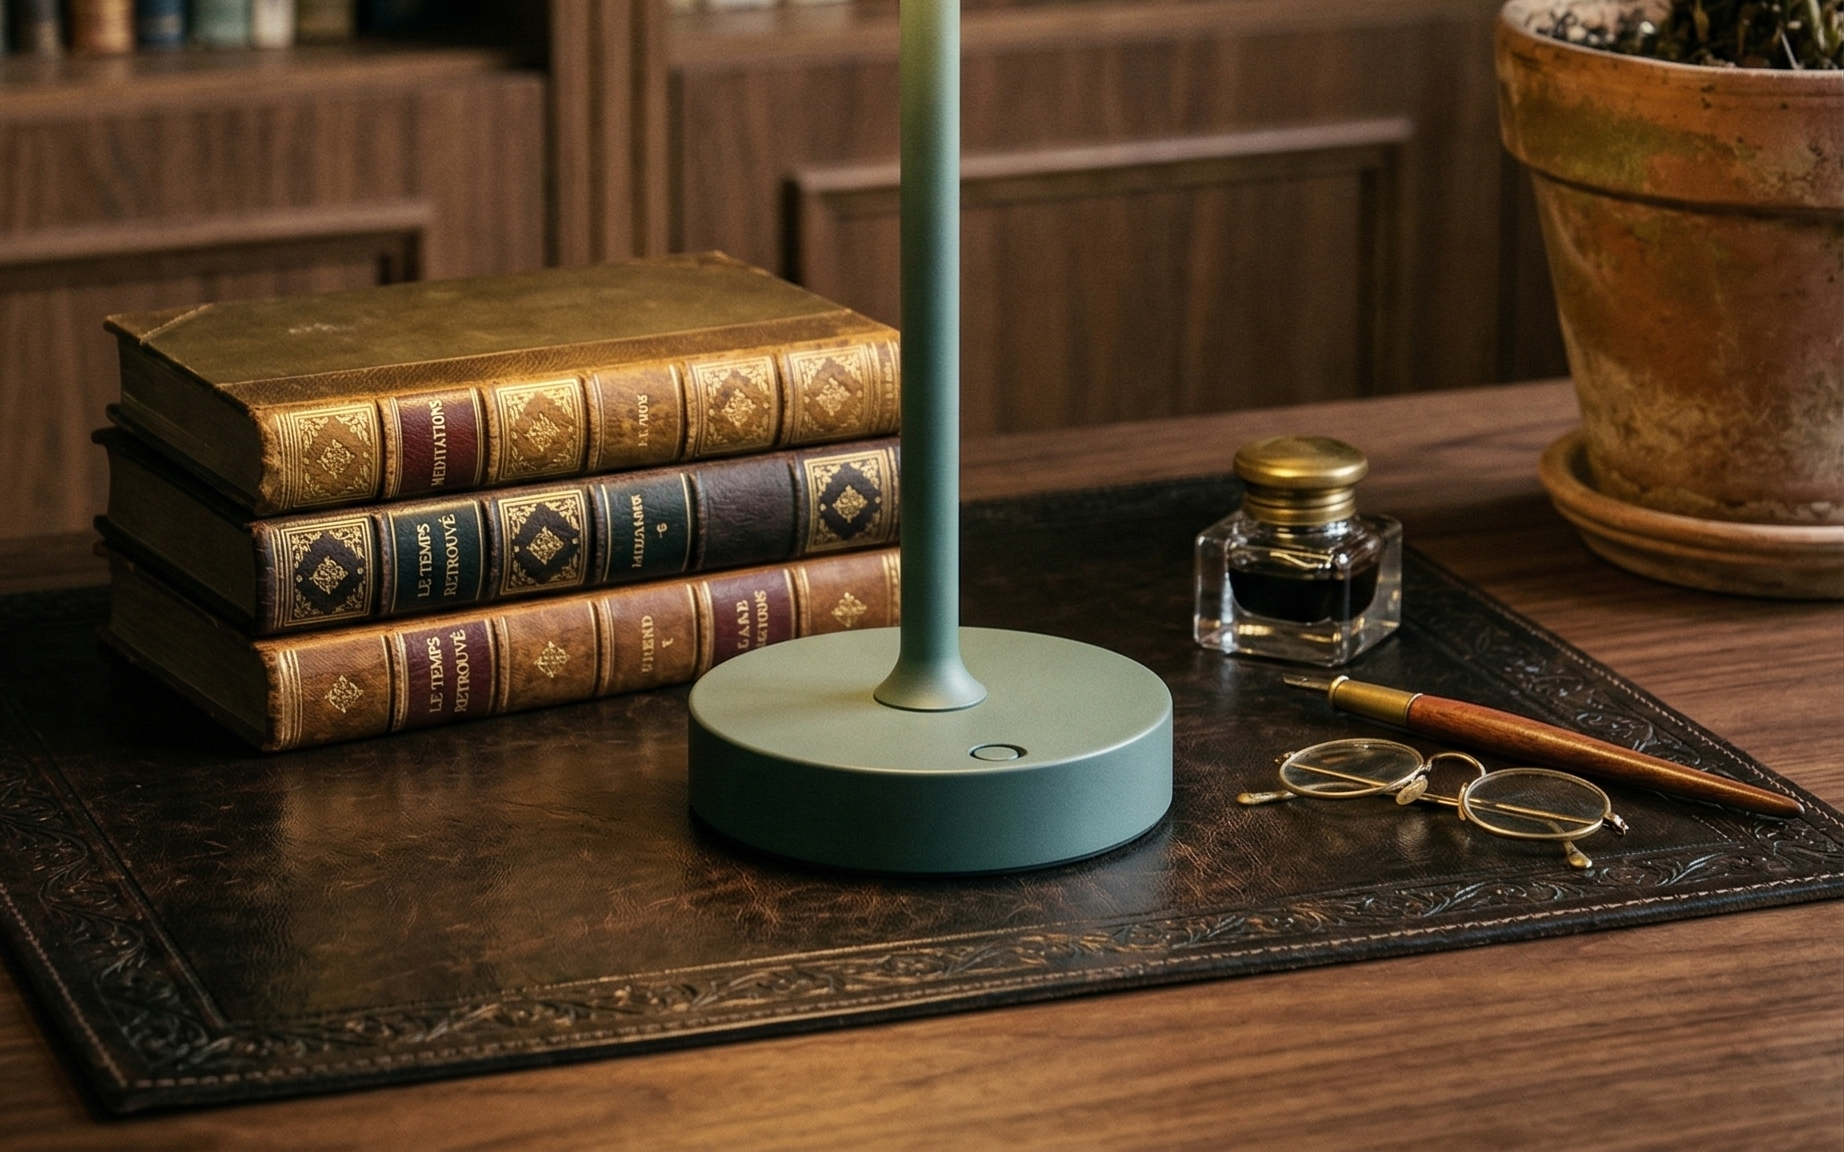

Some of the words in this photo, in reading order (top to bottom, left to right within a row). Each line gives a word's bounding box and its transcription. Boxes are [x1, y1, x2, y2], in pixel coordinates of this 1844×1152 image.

[429, 399, 446, 486] MEDITATIONS
[417, 523, 432, 576] TEMPS
[439, 513, 459, 596] RETROUVÉ
[417, 578, 431, 598] LE
[427, 636, 444, 690] TEMPS
[429, 692, 444, 713] LE
